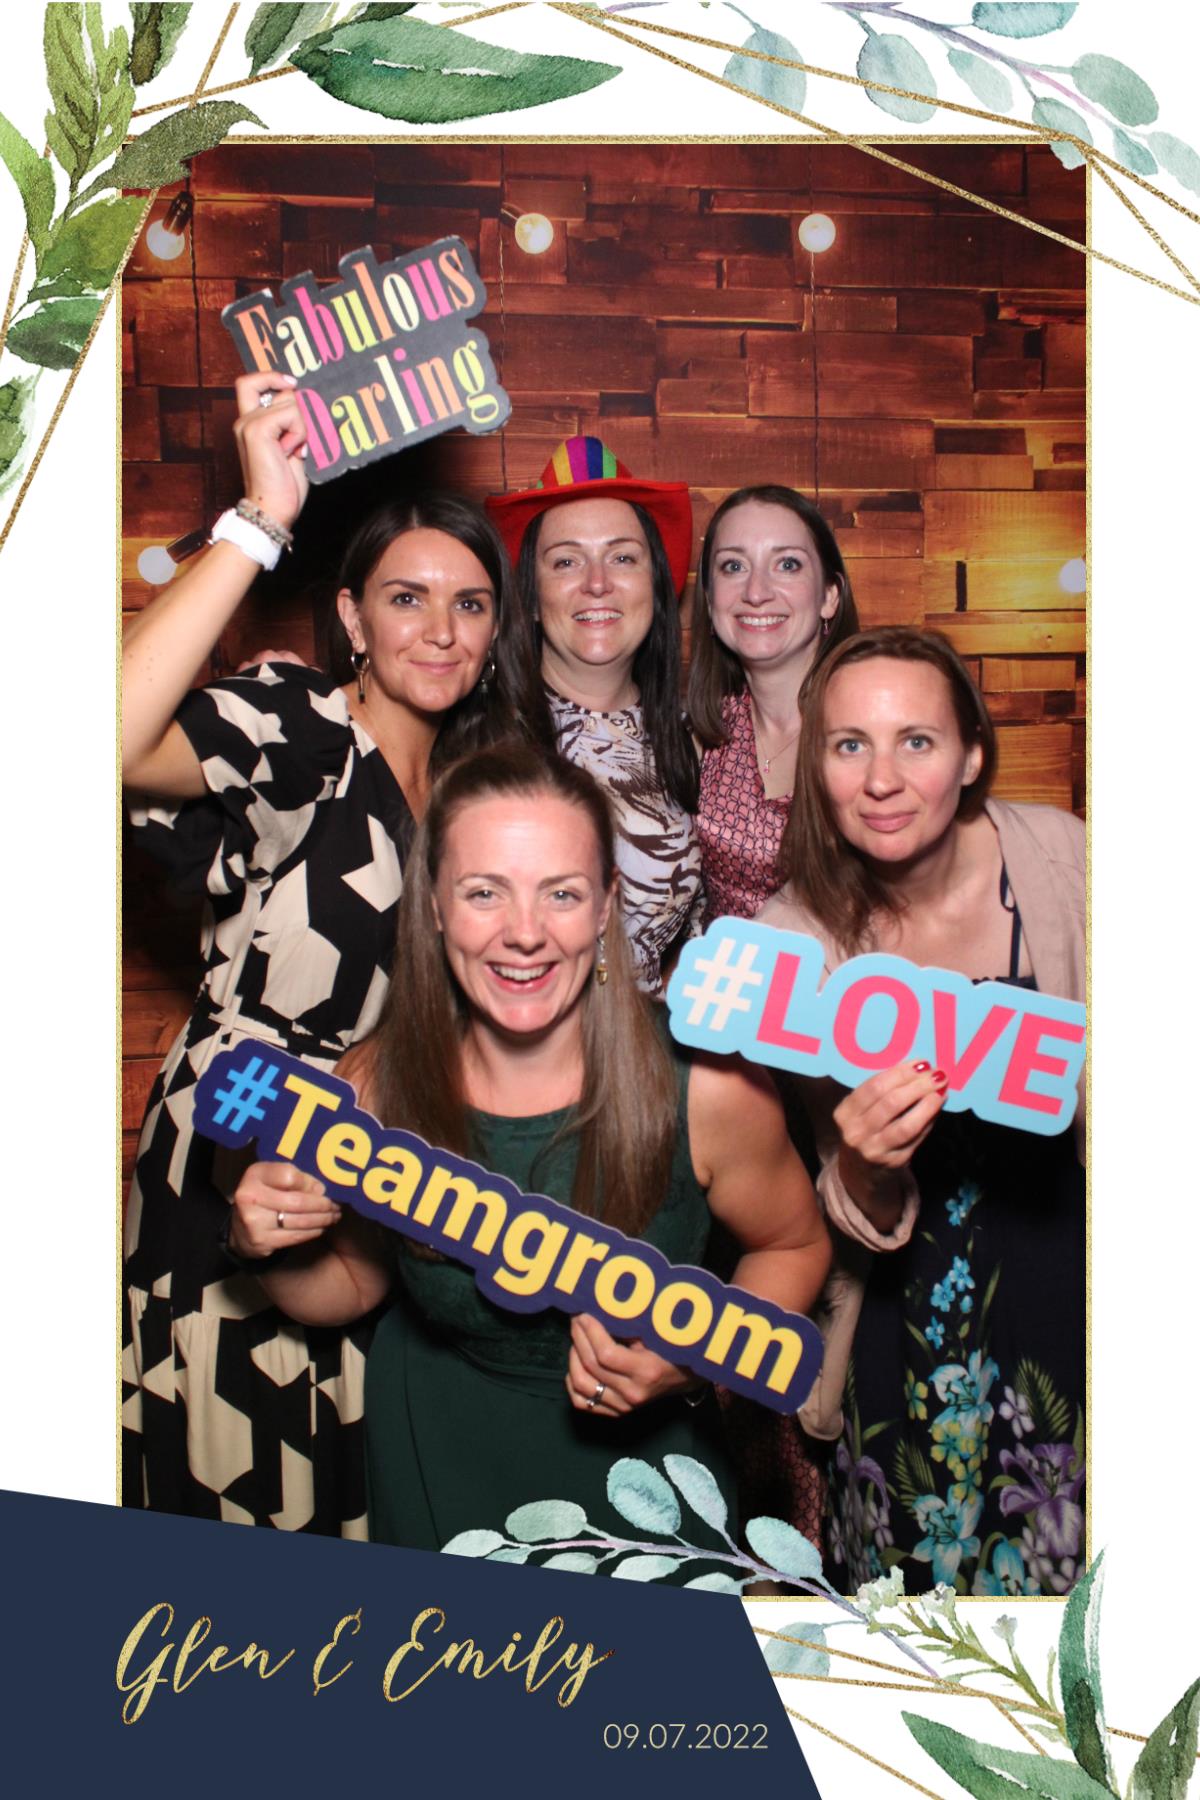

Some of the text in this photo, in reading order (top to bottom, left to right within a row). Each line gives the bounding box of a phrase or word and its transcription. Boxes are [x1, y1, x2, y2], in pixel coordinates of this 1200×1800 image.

[235, 248, 476, 378] Fabulous
[296, 340, 499, 472] Darling
[682, 937, 1086, 1117] #LOVE
[212, 1055, 804, 1396] #Teamgroom
